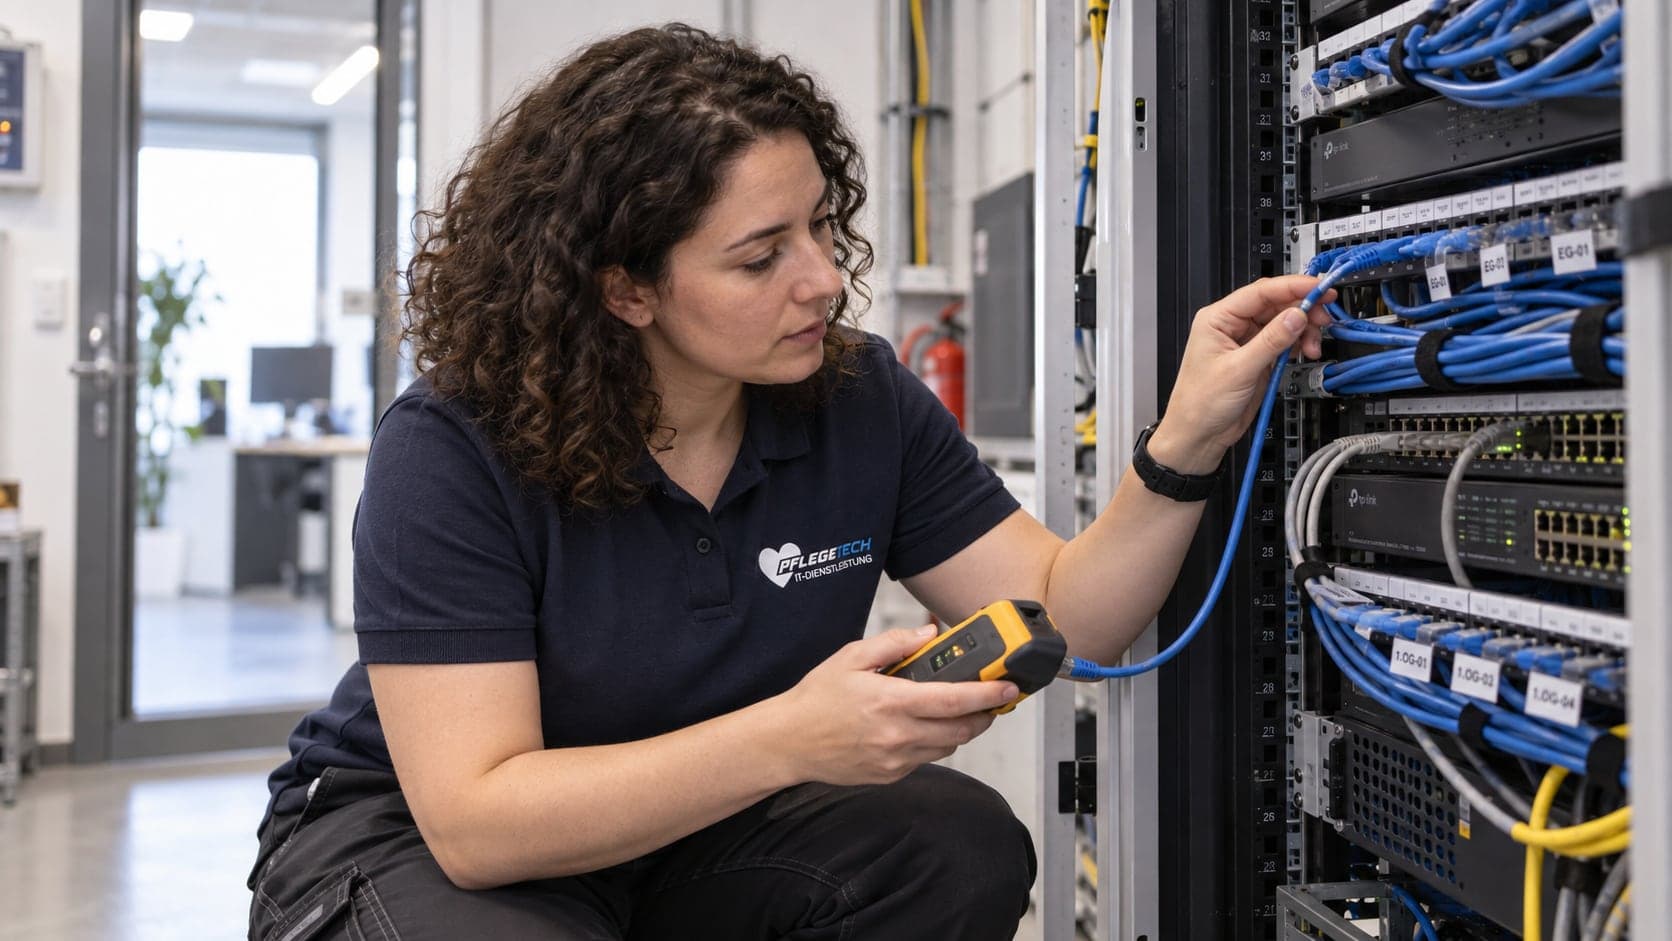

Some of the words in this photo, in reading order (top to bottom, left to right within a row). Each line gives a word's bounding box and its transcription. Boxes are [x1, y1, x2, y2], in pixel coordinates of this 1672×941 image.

[1558, 243, 1590, 260] EG-01
[778, 538, 872, 575] PFLEGETECH
[794, 554, 873, 583] IT-DIENSTLEISTUNG
[1396, 651, 1427, 669] 1.OG-01
